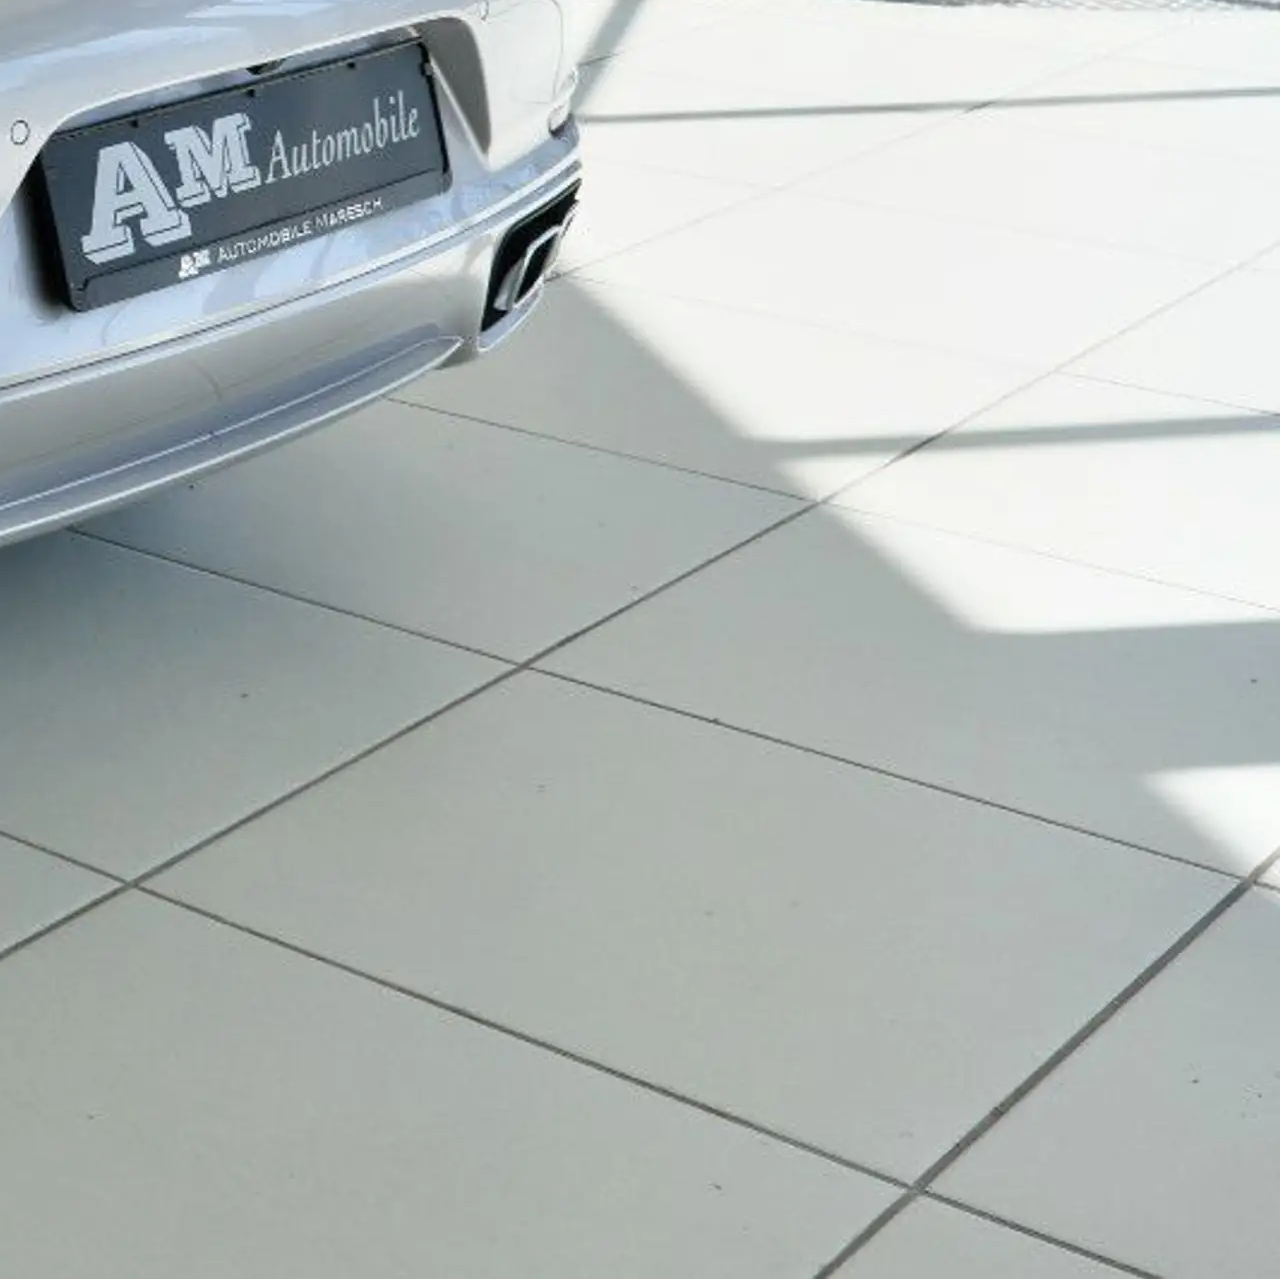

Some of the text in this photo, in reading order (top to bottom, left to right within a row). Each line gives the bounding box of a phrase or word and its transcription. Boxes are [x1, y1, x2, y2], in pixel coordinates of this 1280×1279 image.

[80, 90, 420, 266] AM Automobile
[178, 196, 384, 279] AM AUTOMOBILE MARESCH
